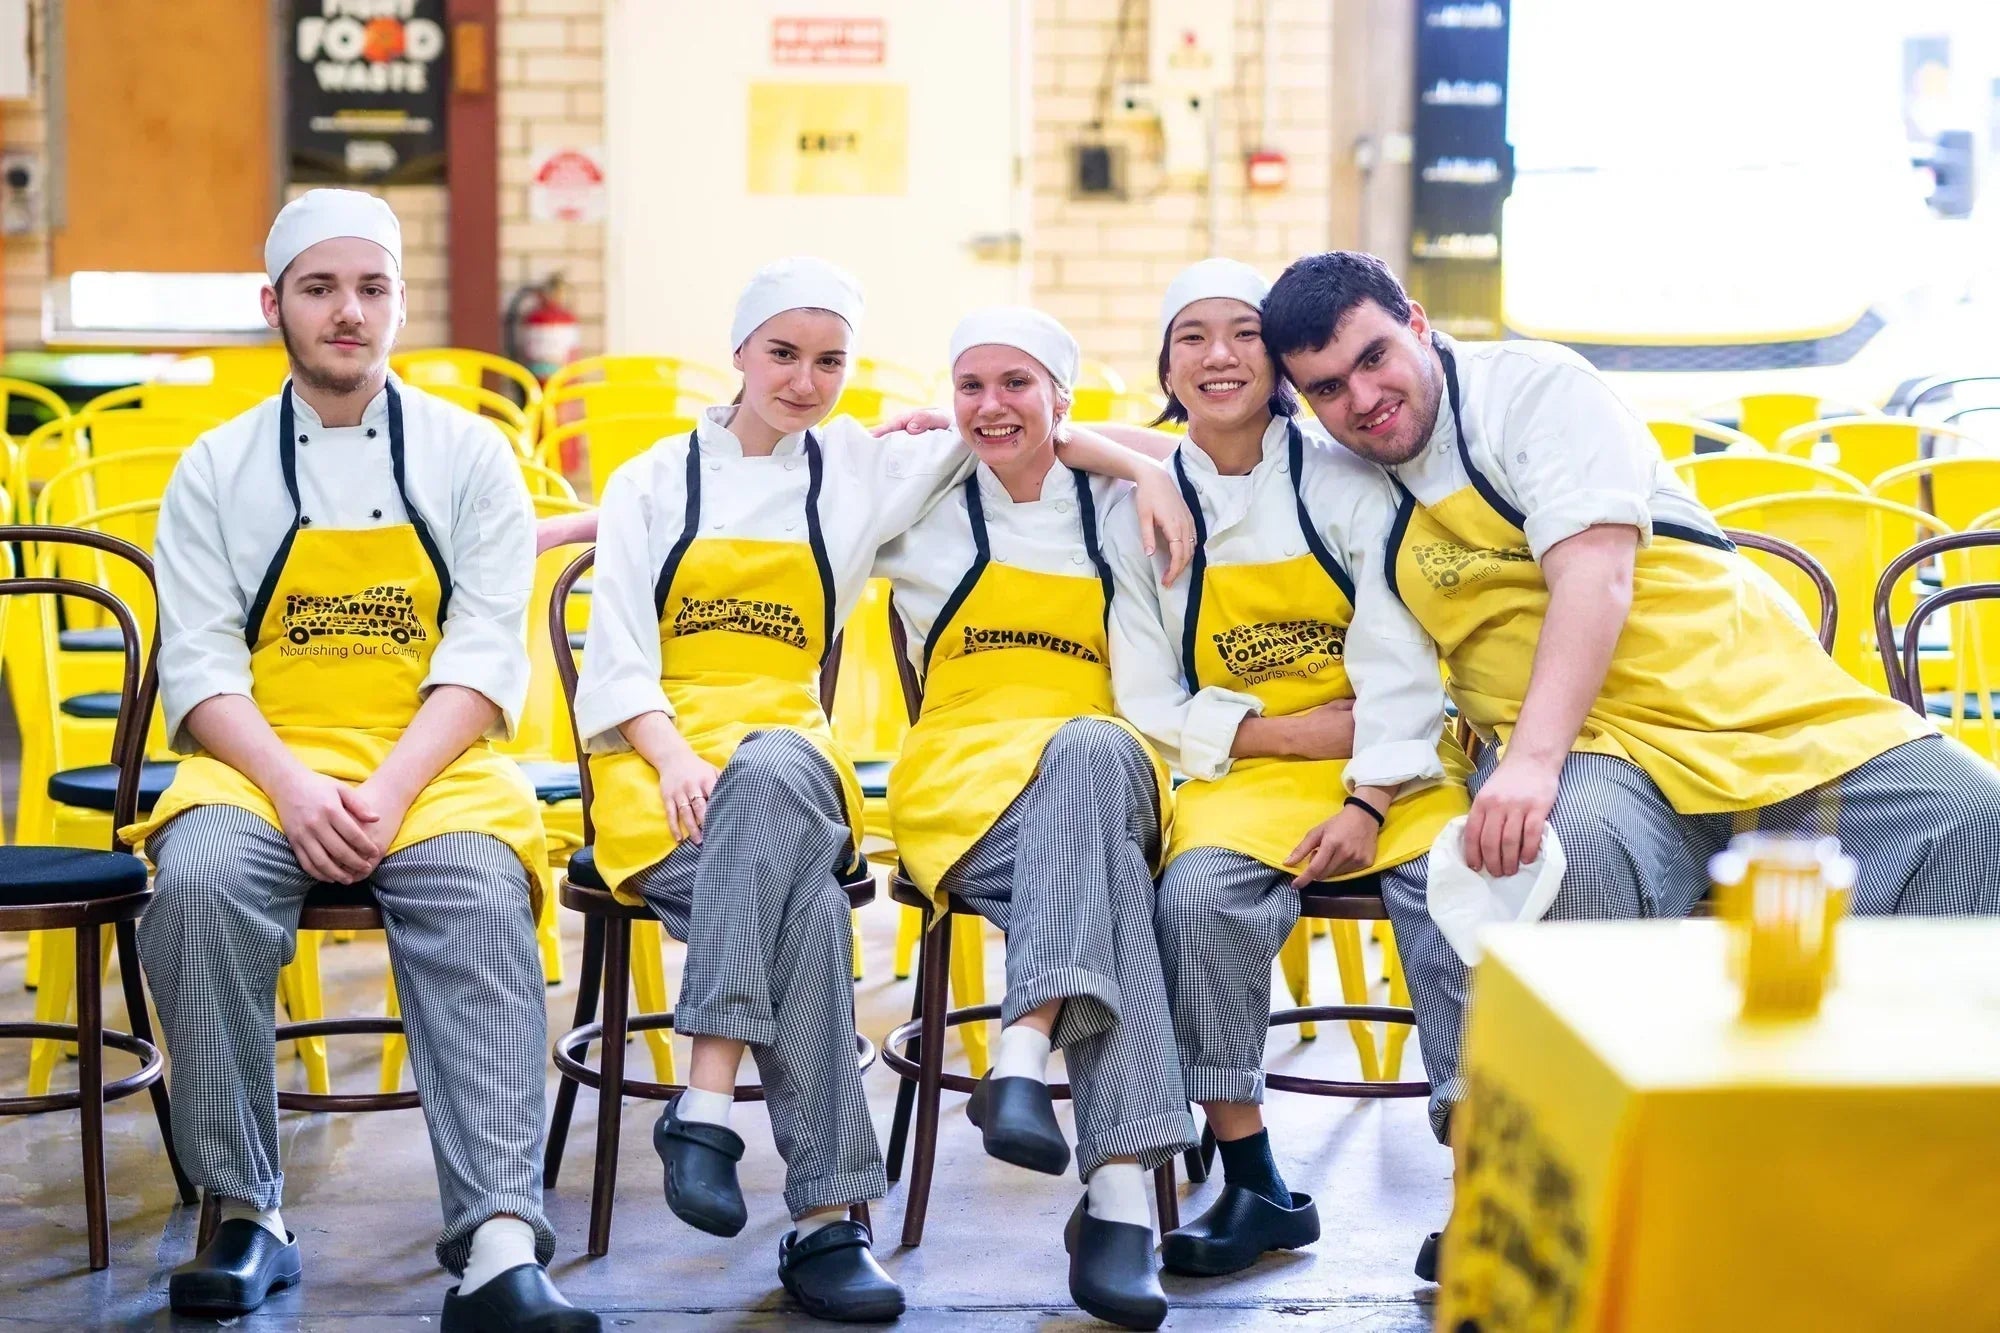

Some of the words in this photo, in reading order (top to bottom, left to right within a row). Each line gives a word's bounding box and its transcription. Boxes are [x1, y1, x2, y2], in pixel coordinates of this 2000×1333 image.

[297, 16, 444, 63] FOOD
[315, 61, 427, 92] WASTE
[324, 602, 408, 621] ARVEST
[729, 615, 794, 638] RVEST
[280, 643, 348, 659] Nourishing
[353, 642, 378, 655] Our
[381, 642, 422, 662] Country
[976, 630, 1083, 655] OZHARVEST
[1235, 626, 1327, 662] OZHARVEST
[1308, 657, 1329, 674] Our
